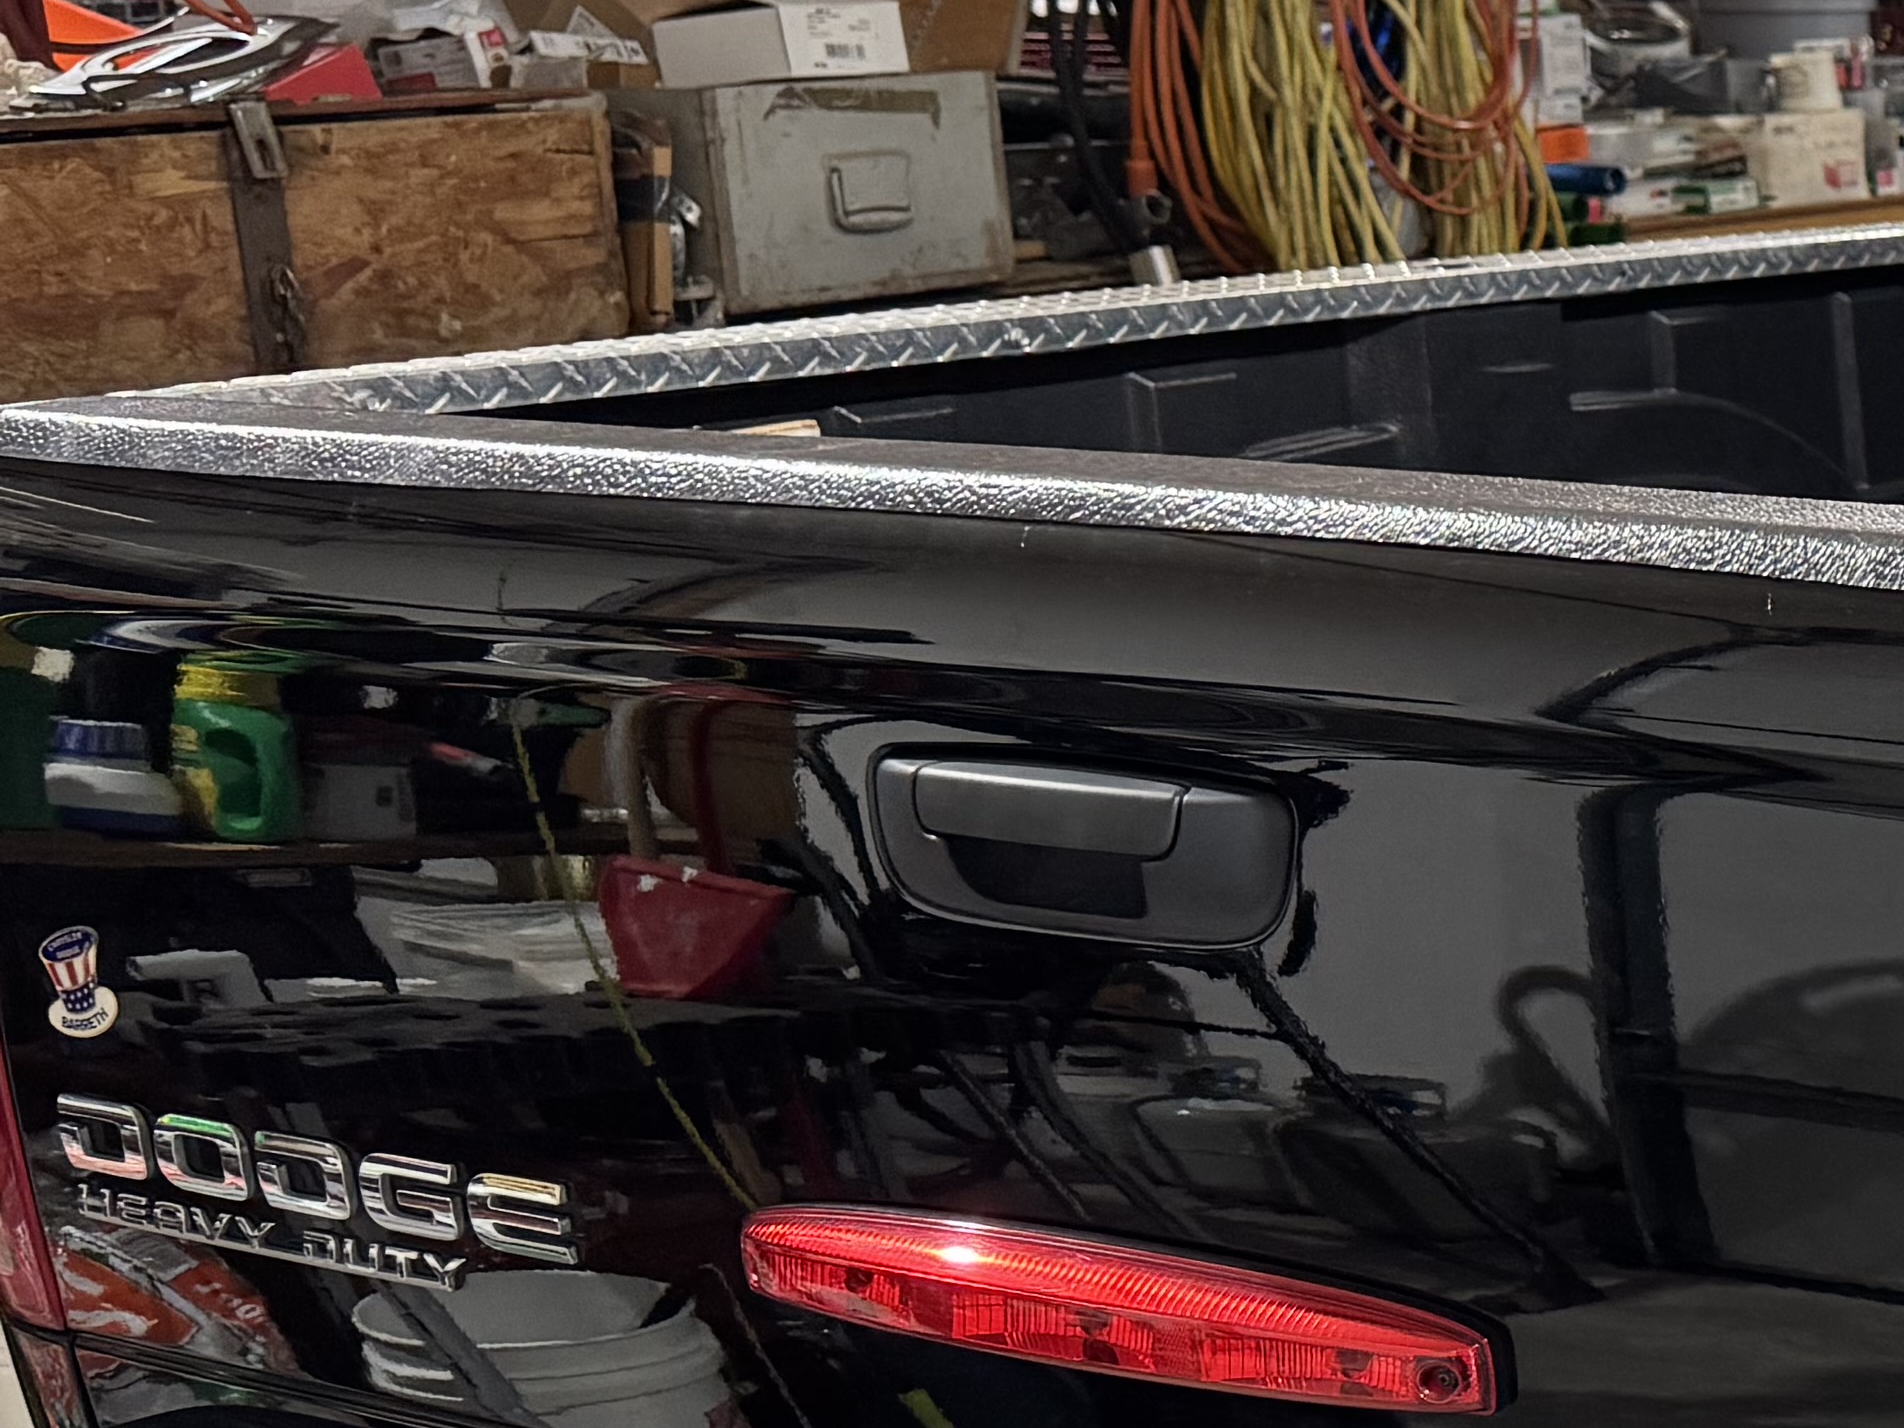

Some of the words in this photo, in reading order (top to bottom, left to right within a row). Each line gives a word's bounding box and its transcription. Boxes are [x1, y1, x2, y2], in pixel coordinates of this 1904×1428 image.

[57, 1092, 579, 1266] DODGE
[77, 1182, 276, 1250] HEAVY
[302, 1228, 467, 1292] DUTY
